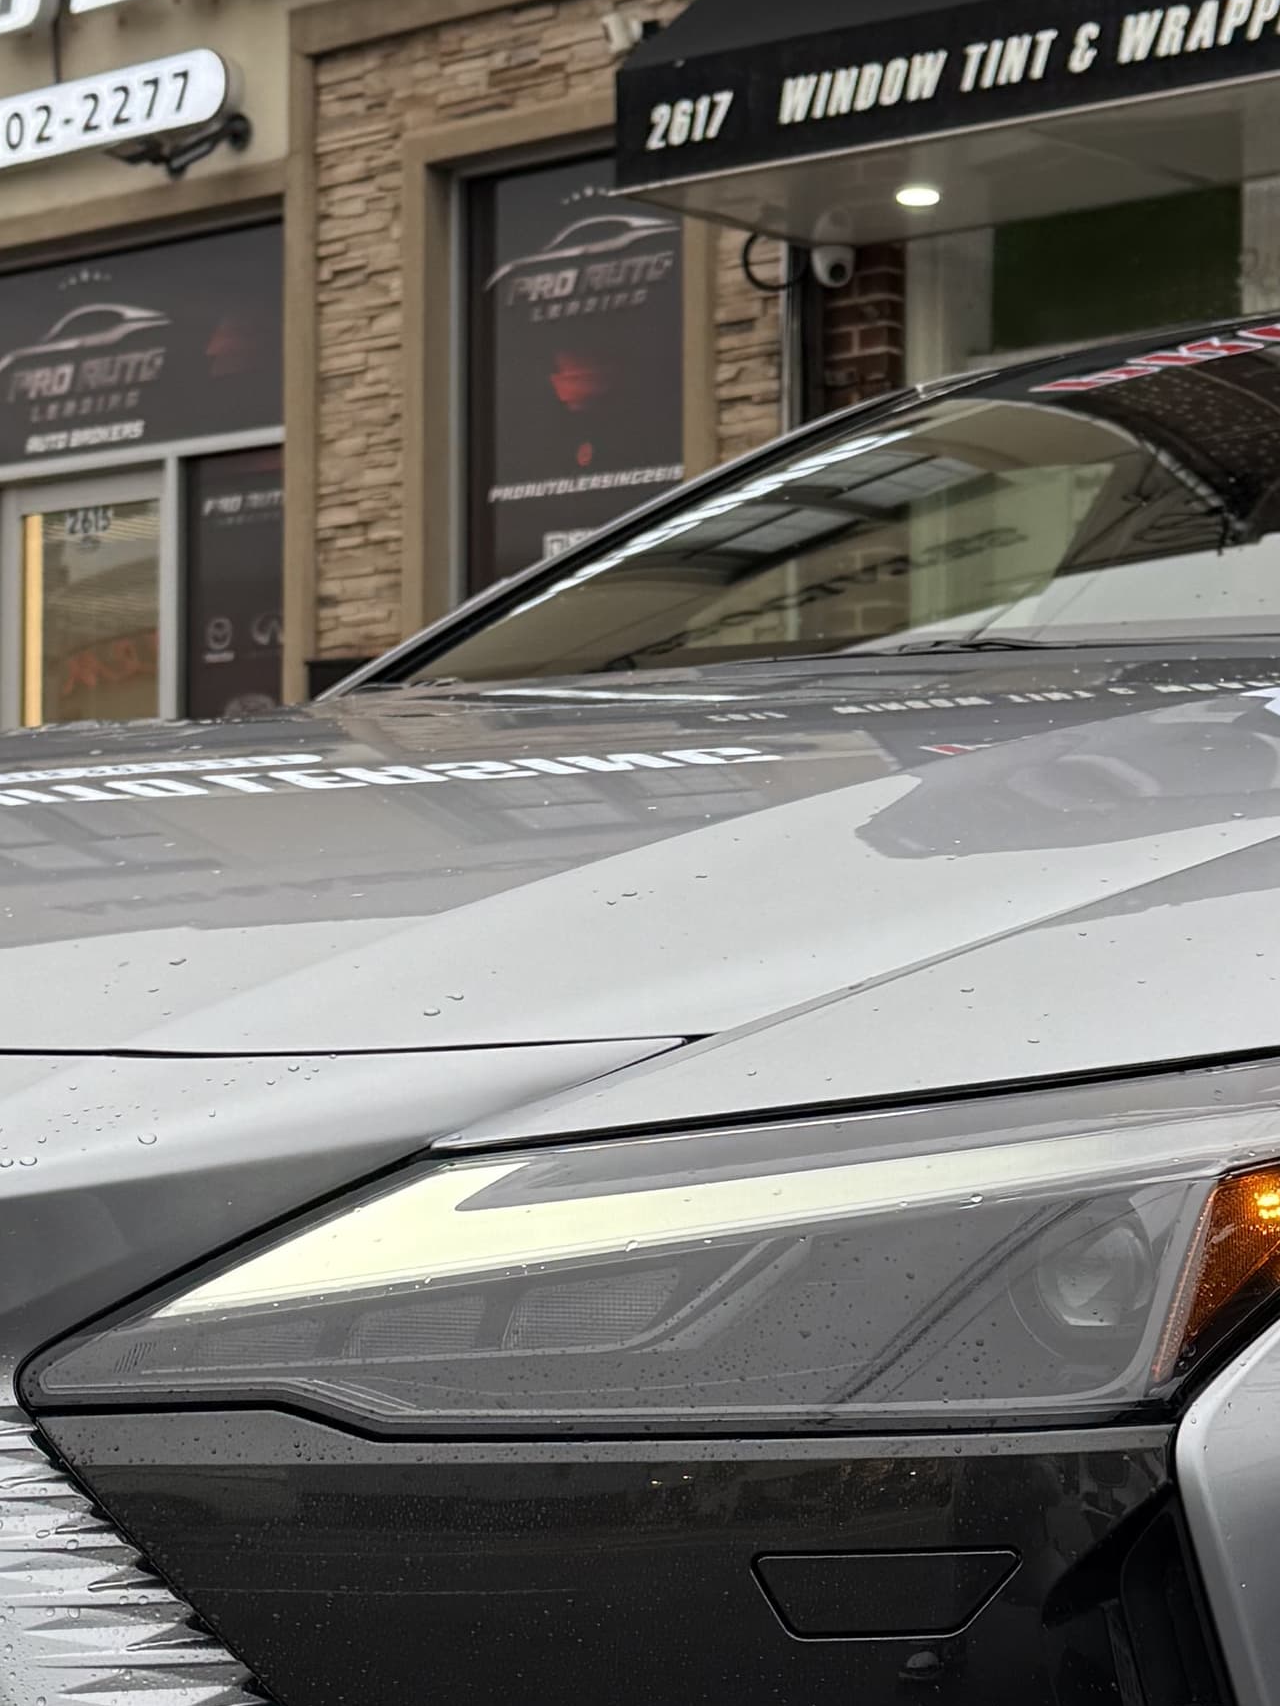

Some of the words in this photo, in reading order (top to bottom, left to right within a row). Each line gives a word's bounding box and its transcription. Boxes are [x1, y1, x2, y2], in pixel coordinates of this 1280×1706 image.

[646, 90, 734, 151] 2617
[778, 48, 948, 125] WINDOW
[960, 27, 1059, 93] TINT
[1068, 20, 1101, 75] &
[508, 269, 578, 306] PRO
[7, 363, 75, 404] PRO
